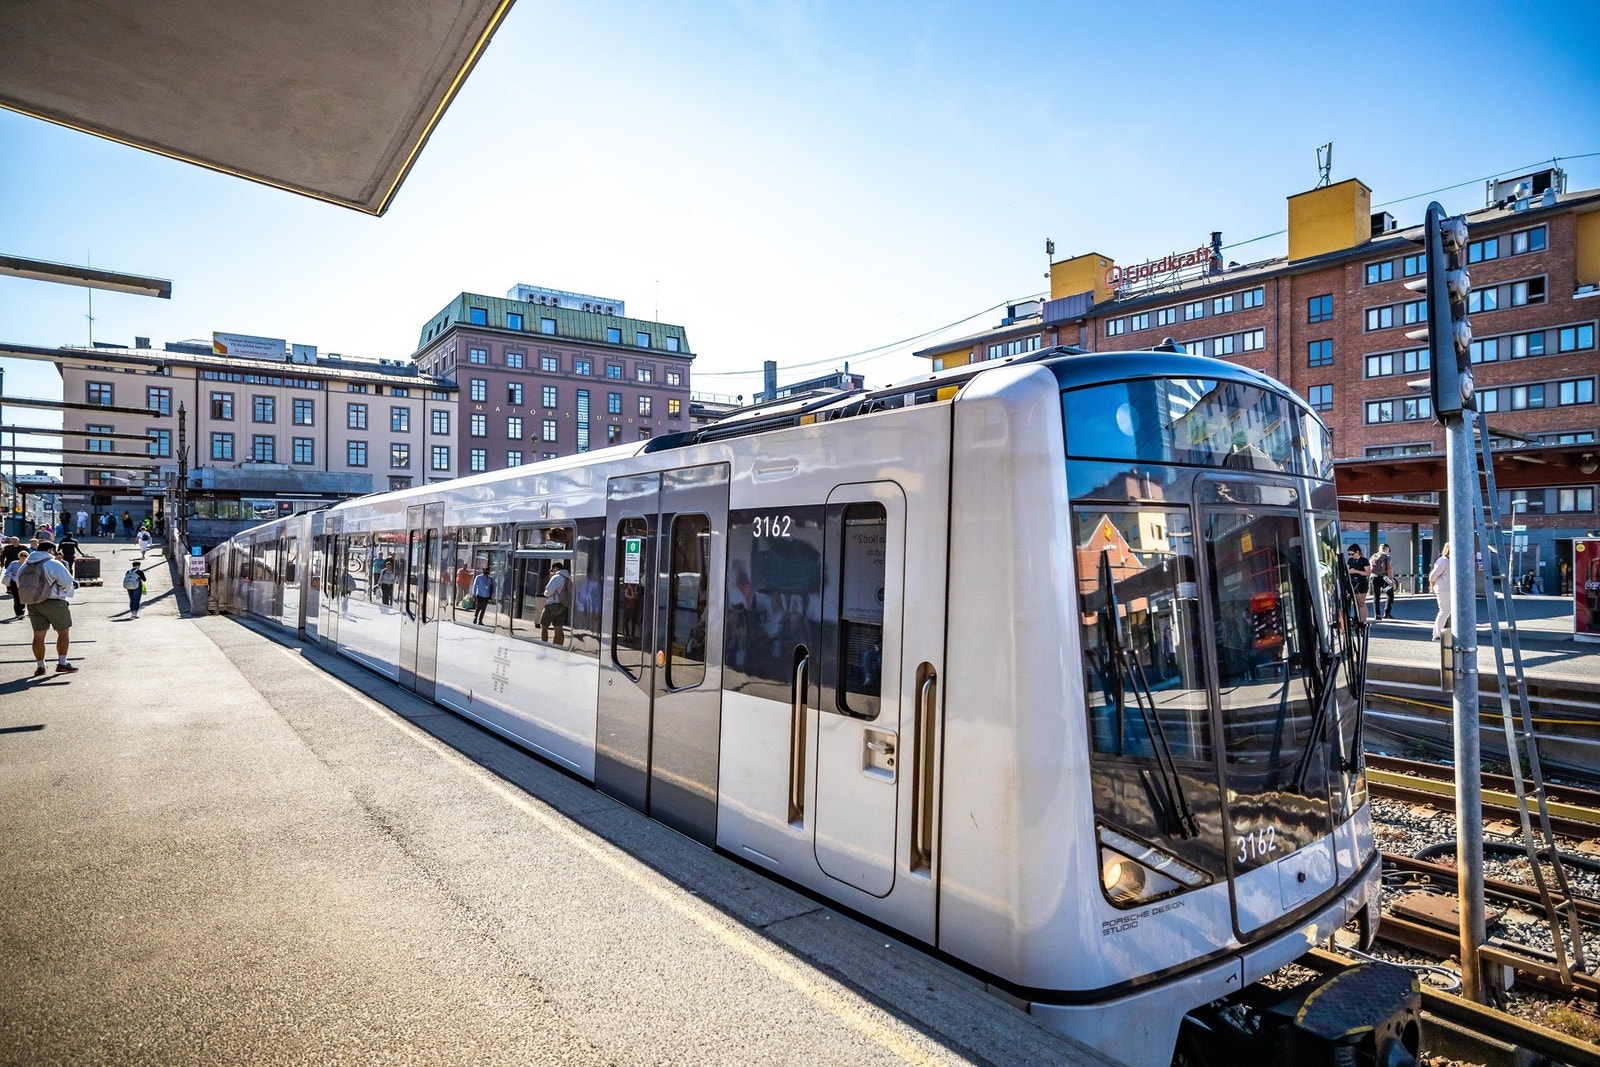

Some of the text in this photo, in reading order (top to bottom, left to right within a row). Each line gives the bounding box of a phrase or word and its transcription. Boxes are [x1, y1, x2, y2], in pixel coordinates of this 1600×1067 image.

[753, 515, 791, 537] 3162
[1236, 825, 1276, 863] 3162
[1102, 901, 1185, 929] PORSCHE DESIGN
[1102, 921, 1138, 936] STUDIO
